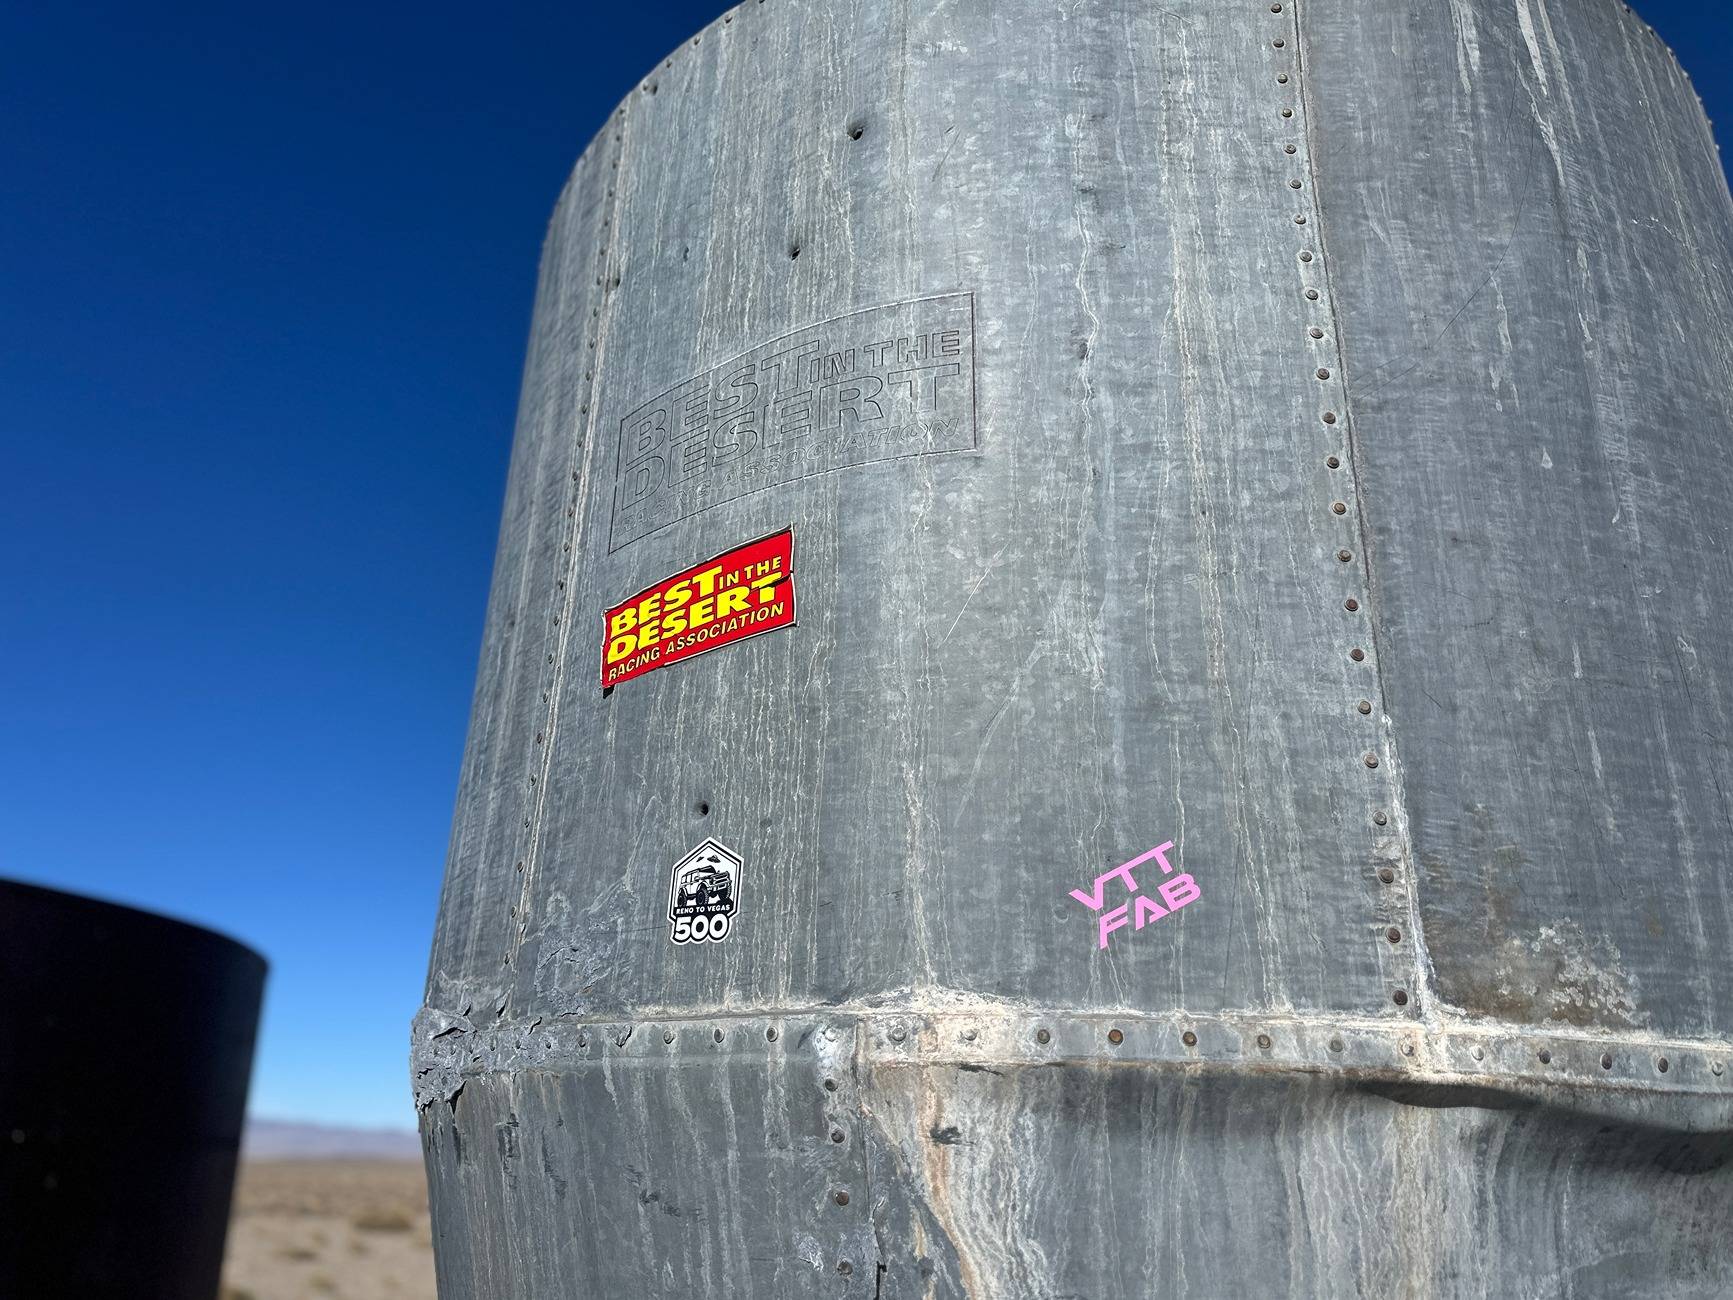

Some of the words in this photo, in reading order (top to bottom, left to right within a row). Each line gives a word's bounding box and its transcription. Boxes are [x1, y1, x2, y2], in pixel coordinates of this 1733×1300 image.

[622, 362, 961, 511] DESERT
[624, 339, 820, 466] BEST
[809, 348, 855, 384] IN
[863, 330, 961, 369] THE
[607, 571, 782, 665] DESERT
[610, 565, 722, 639] BEST
[719, 570, 739, 590] IN
[743, 556, 782, 579] THE
[608, 646, 660, 681] RACING
[665, 602, 784, 655] ASSOCIATION
[676, 905, 694, 914] RENO
[707, 904, 731, 912] VEGAS
[1068, 840, 1174, 911] VTT
[1100, 873, 1201, 950] FAB
[673, 913, 729, 941] 500
